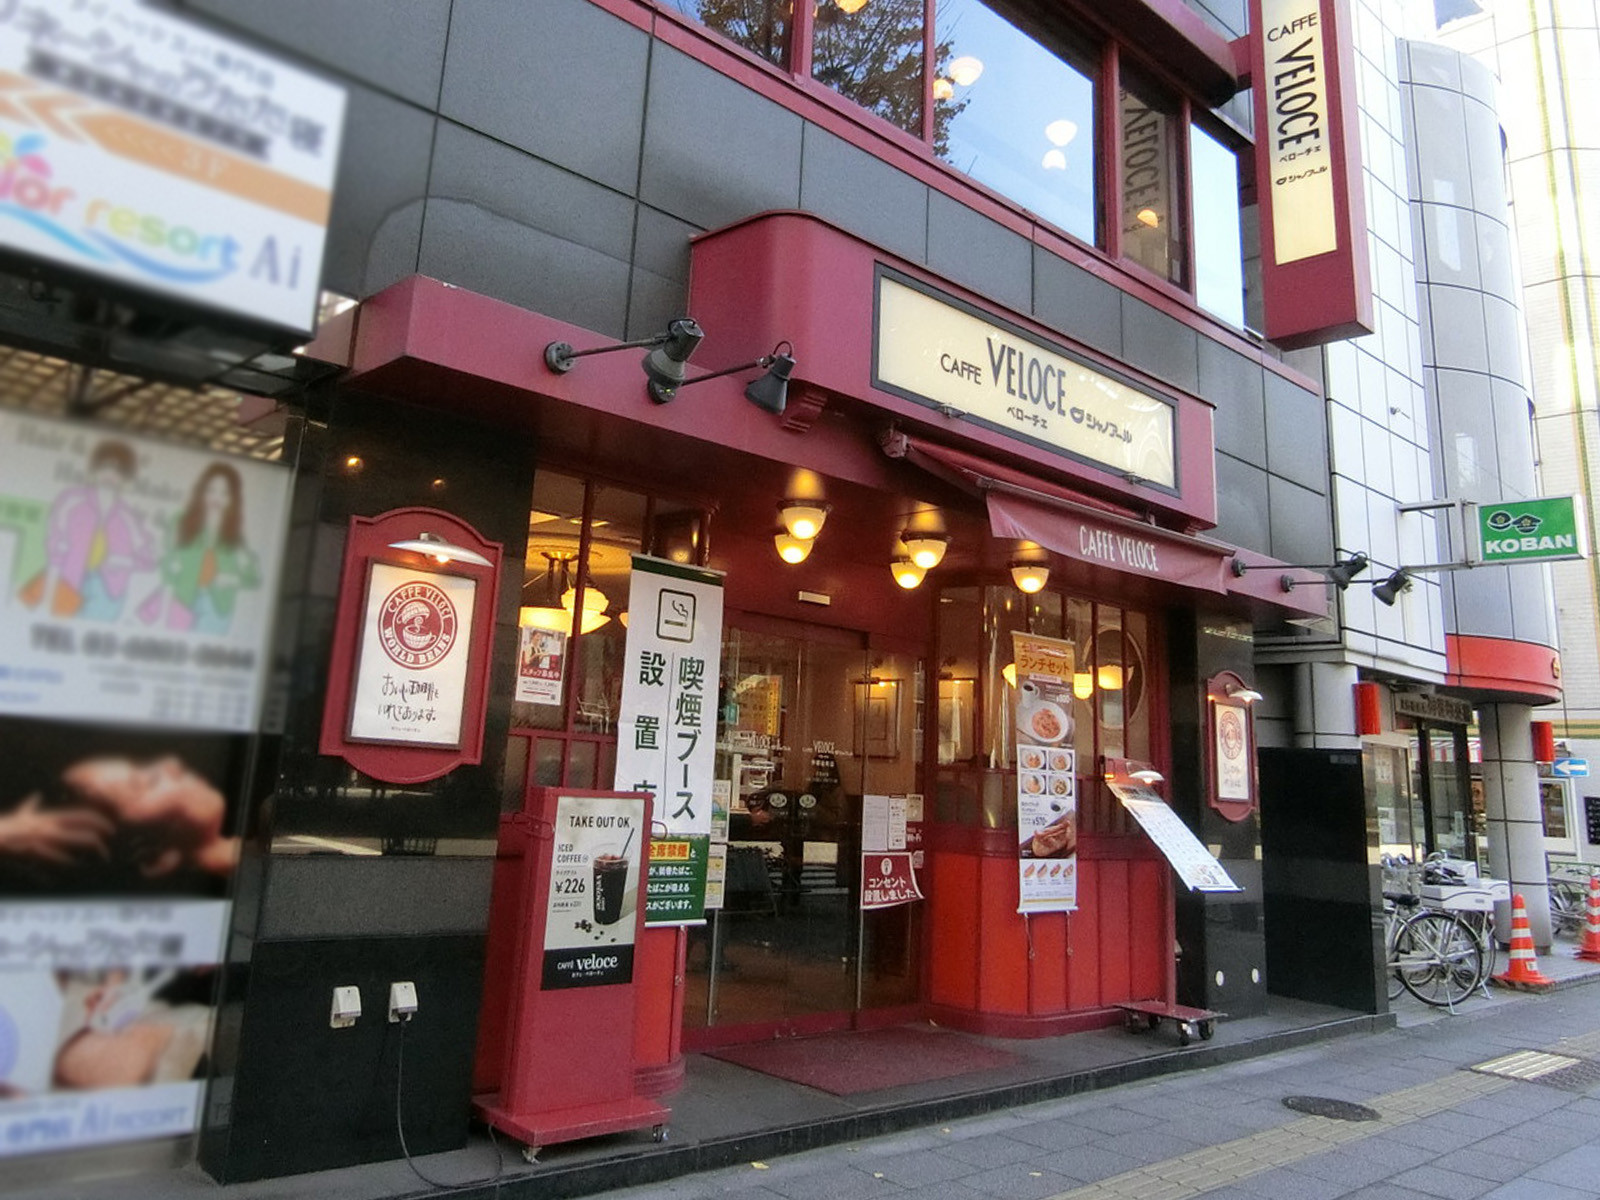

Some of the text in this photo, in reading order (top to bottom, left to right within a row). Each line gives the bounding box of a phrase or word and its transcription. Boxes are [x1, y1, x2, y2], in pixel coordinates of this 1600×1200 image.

[1267, 12, 1320, 151] CAFFE VELOCE
[1279, 145, 1322, 162] ベローチェ
[85, 197, 241, 273] resort
[249, 233, 304, 291] Ai
[940, 337, 1066, 416] CAFFE VELOCE
[1007, 406, 1048, 430] ベローチェ
[1086, 413, 1133, 444] シャノアール
[1116, 535, 1159, 571] VELOCE
[1485, 534, 1573, 554] KOBAN
[384, 627, 415, 664] WORLD
[1020, 656, 1070, 675] ランチセット
[672, 655, 705, 820] 喫煙ブース
[570, 815, 631, 828] TAKE OUT OK
[557, 843, 574, 852] ICED
[557, 854, 582, 863] COFFEE
[555, 877, 586, 894] ¥226
[868, 876, 907, 888] コンセント
[576, 953, 618, 971] veloce
